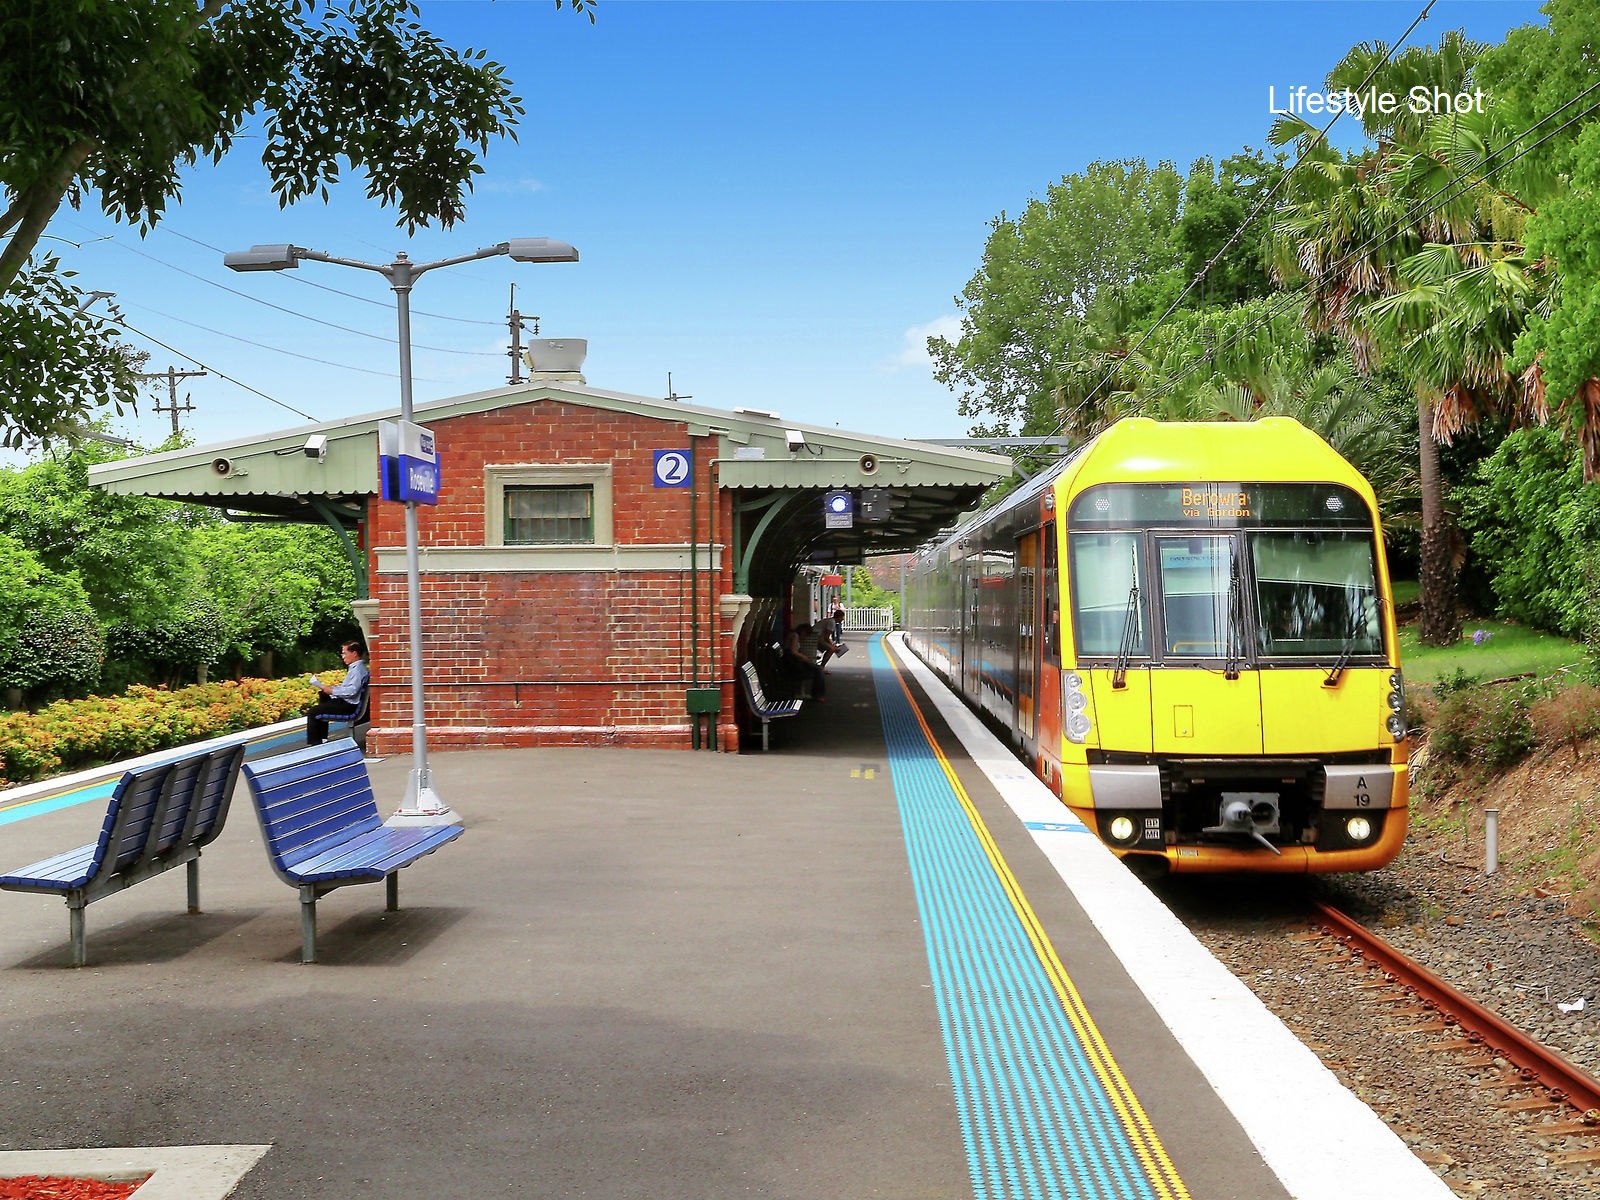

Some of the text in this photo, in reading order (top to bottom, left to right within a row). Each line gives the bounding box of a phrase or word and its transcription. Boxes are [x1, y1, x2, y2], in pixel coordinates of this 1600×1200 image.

[665, 456, 681, 480] 2
[1181, 487, 1247, 506] Berowra
[1182, 507, 1251, 517] via Gordon
[1356, 776, 1368, 789] A
[1353, 793, 1370, 807] 19
